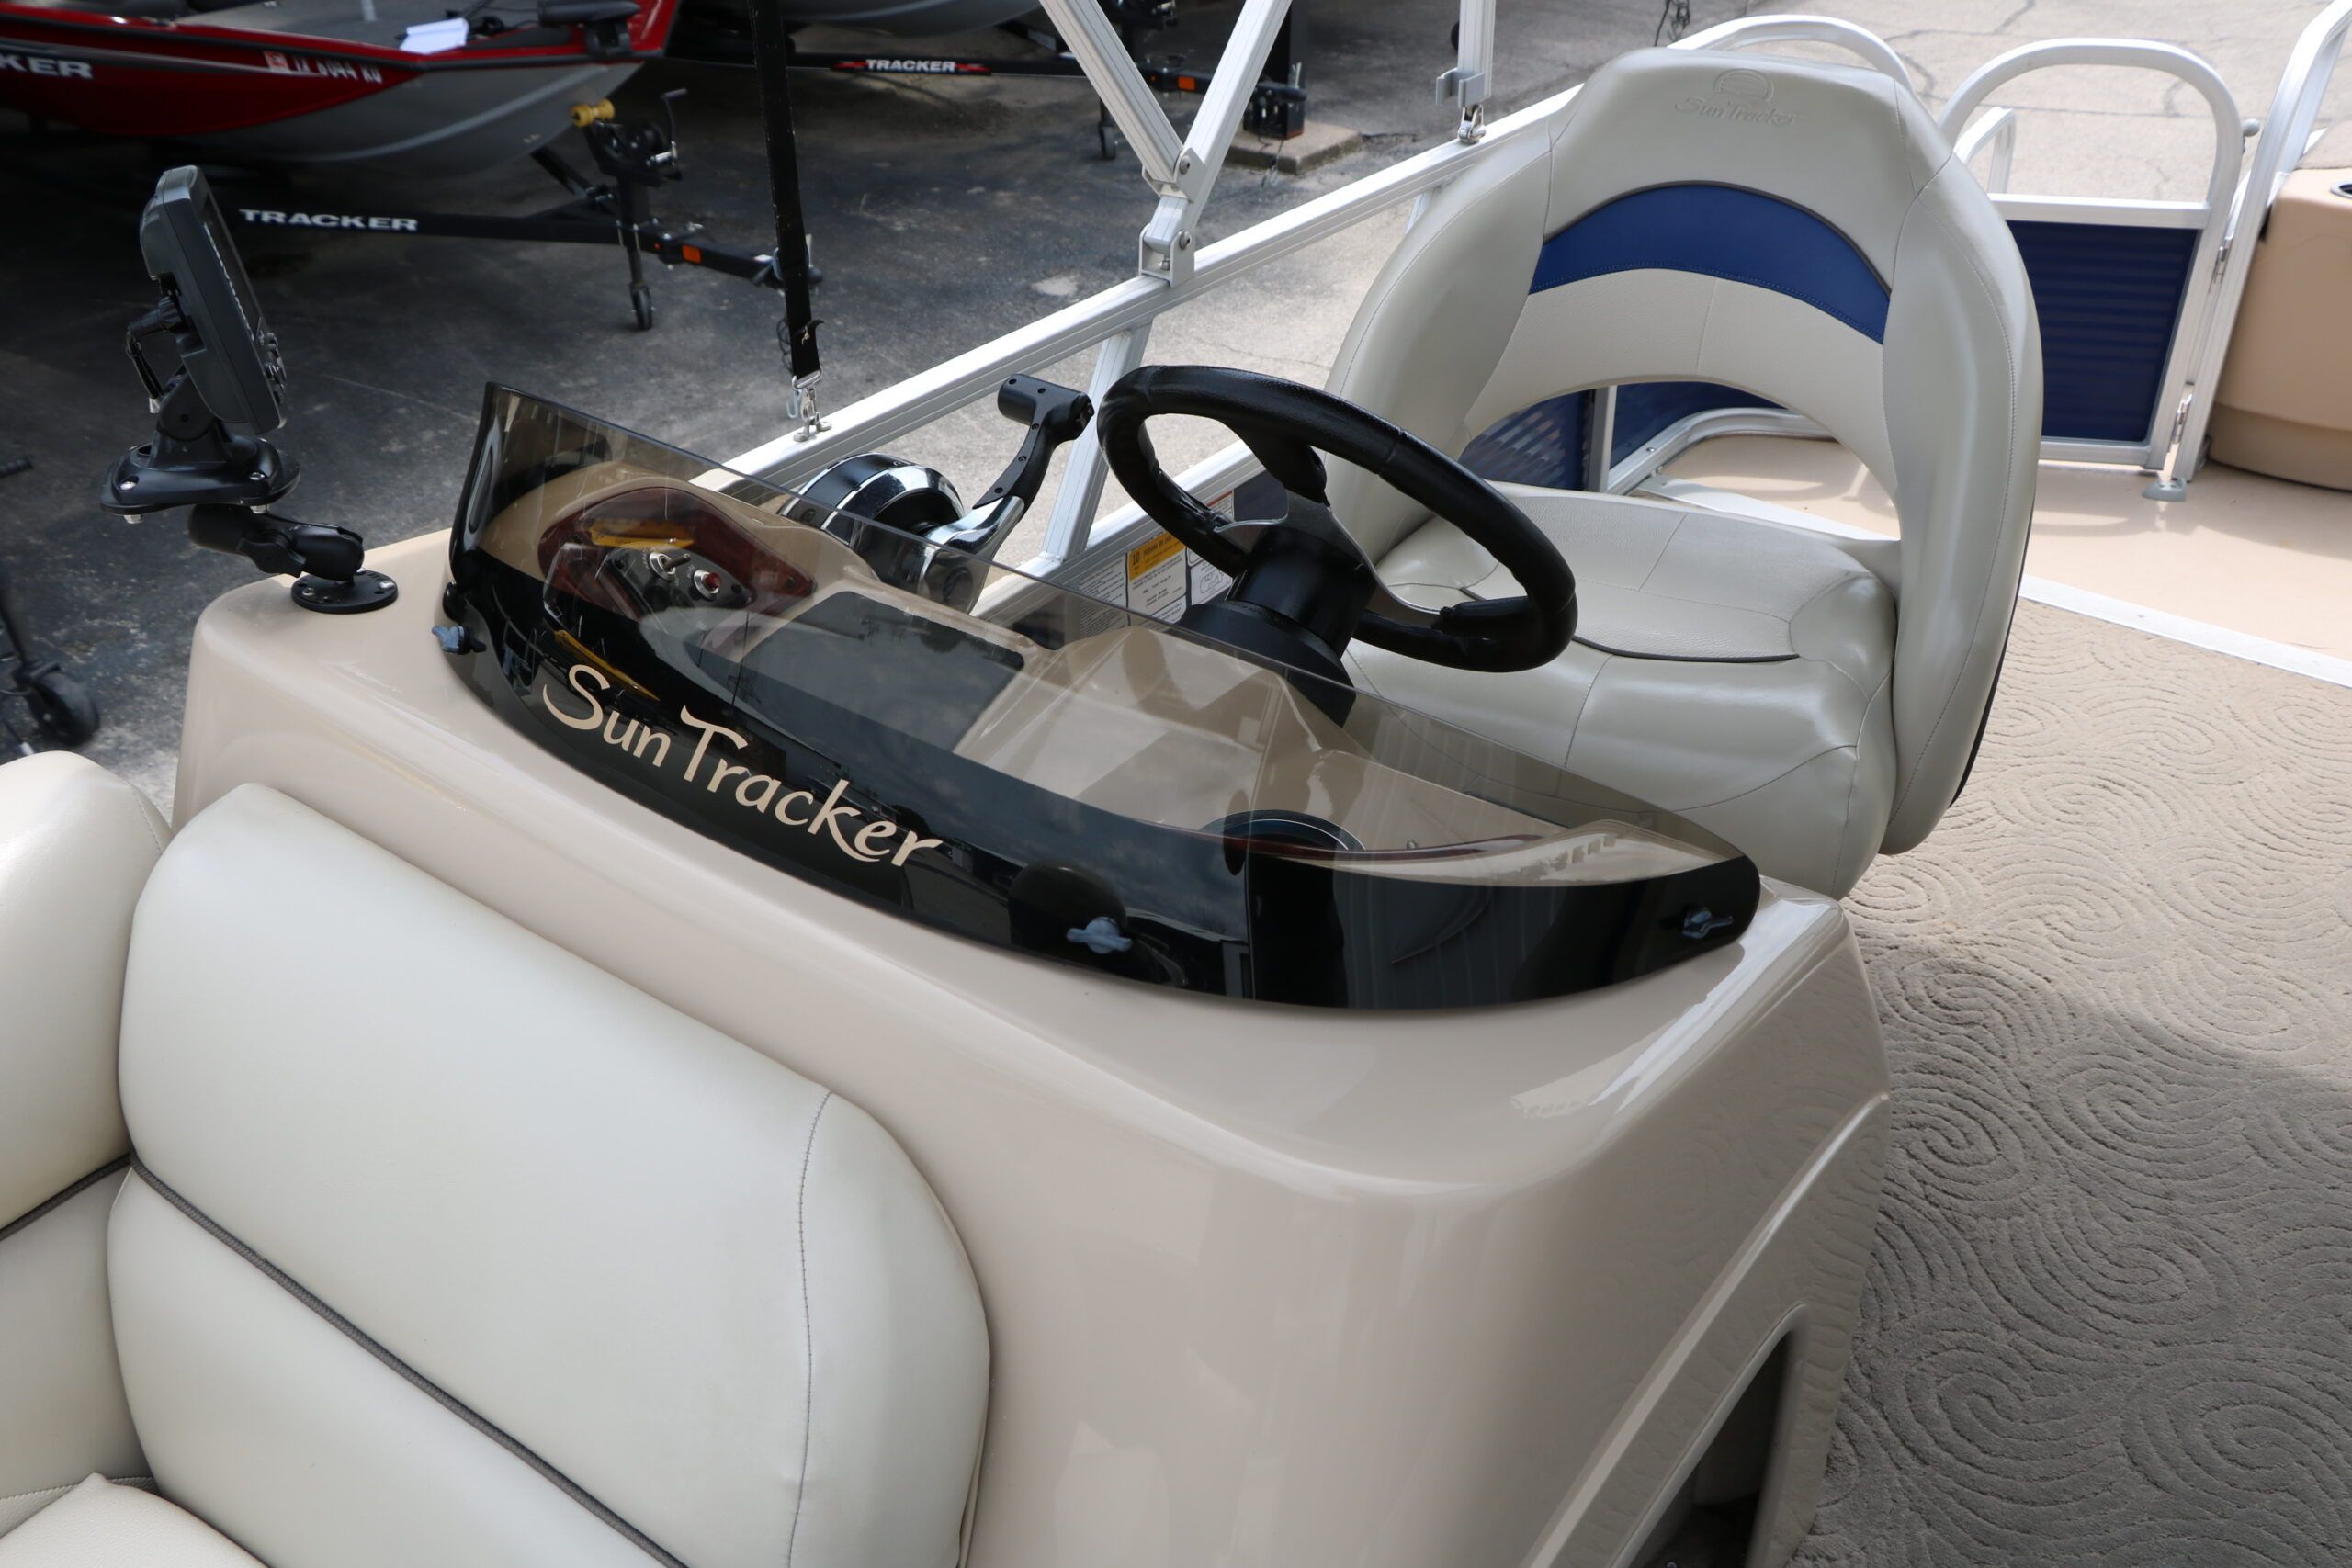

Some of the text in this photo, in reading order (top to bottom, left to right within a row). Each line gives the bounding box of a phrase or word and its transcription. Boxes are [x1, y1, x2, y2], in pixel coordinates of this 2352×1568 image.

[865, 58, 957, 73] TRACKER
[238, 208, 419, 231] TRACKER
[542, 664, 944, 867] Sun Tracker
